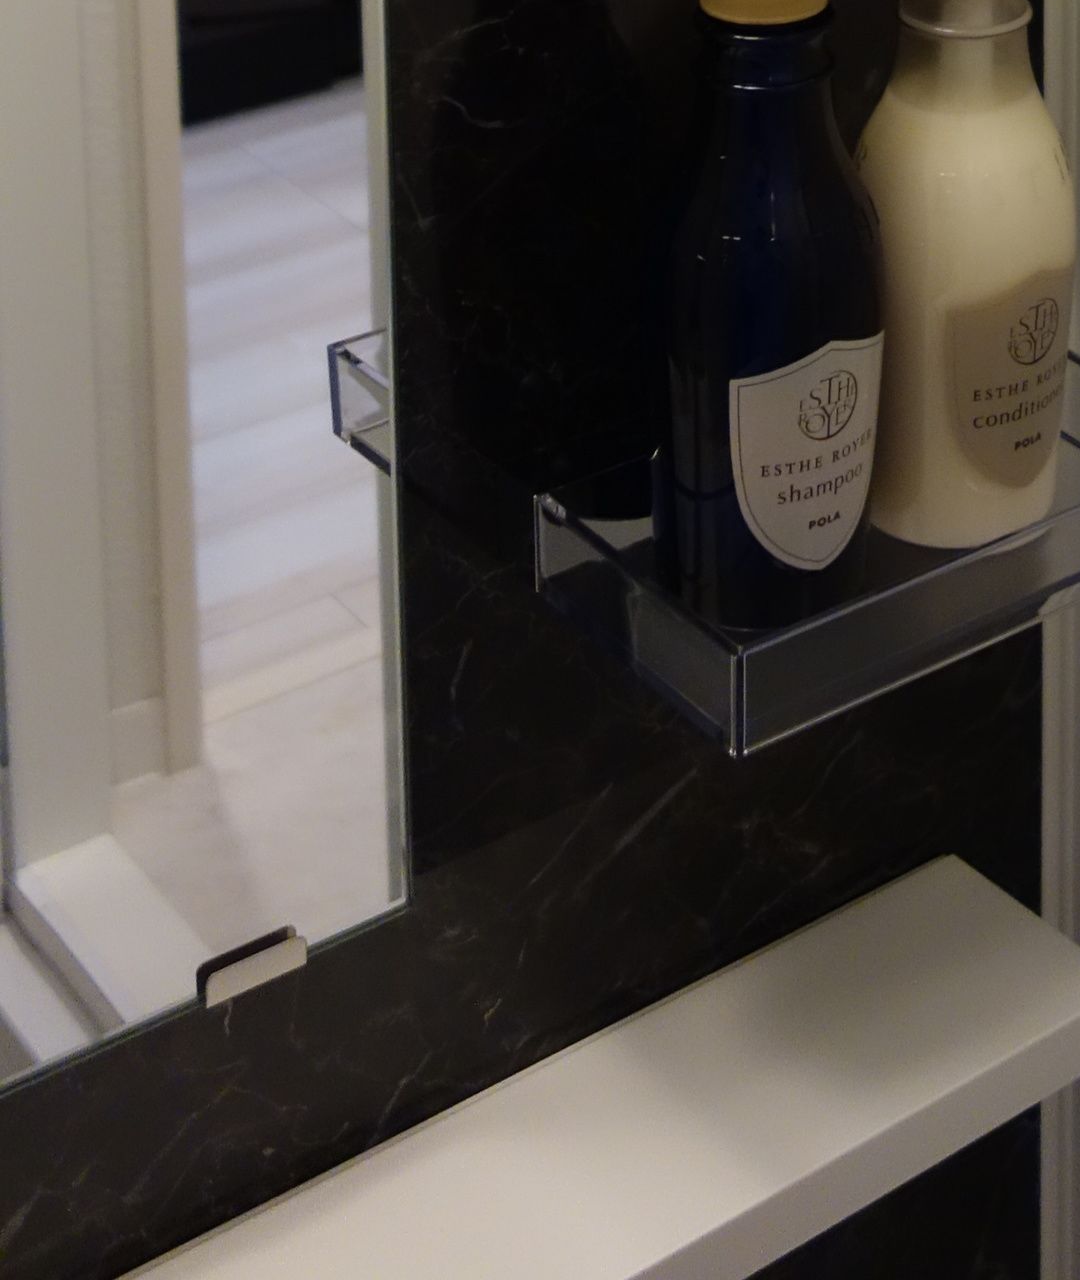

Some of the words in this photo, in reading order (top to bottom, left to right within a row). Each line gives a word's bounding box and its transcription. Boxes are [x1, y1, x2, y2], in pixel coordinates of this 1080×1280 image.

[972, 380, 1028, 402] ESTHE
[1036, 354, 1067, 386] ROY
[1013, 431, 1042, 452] POLA
[760, 455, 823, 478] ESTHE
[777, 463, 863, 505] shampoo
[808, 510, 841, 530] POLA
